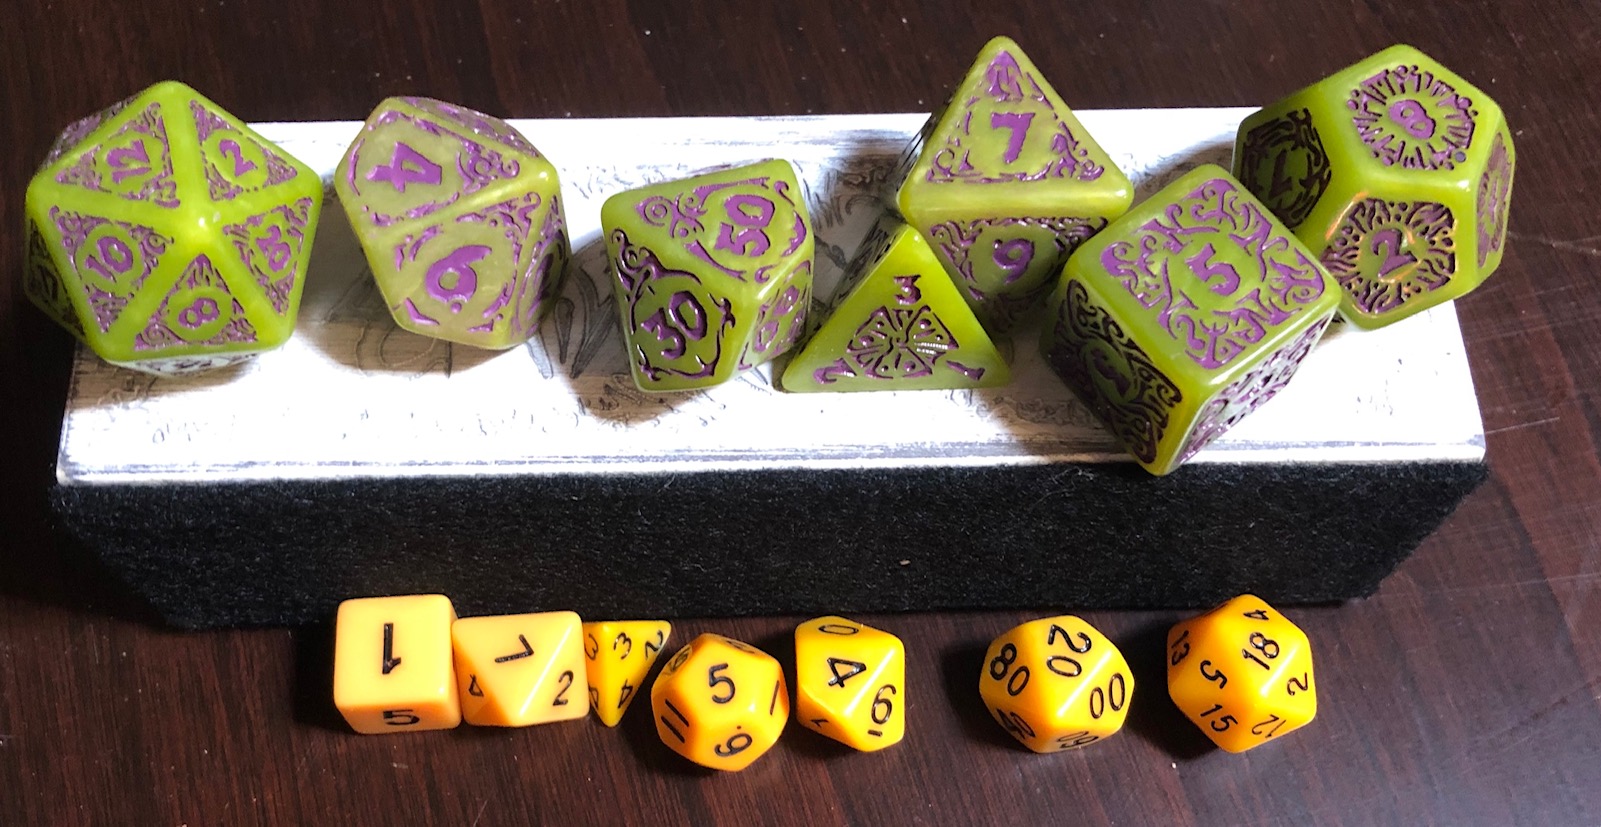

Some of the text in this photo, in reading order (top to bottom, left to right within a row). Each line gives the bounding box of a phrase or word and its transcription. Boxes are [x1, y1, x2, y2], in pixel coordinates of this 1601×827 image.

[991, 112, 1035, 164] 7
[1388, 99, 1436, 140] 8
[105, 139, 152, 184] 12
[218, 139, 258, 177] 2
[366, 141, 442, 193] 4
[713, 194, 776, 257] 50
[84, 236, 133, 283] 10
[1184, 243, 1241, 296] 5
[1372, 228, 1418, 278] 2
[425, 245, 492, 301] 6
[893, 274, 921, 305] 3
[178, 297, 220, 329] 8
[640, 290, 708, 360] 30
[812, 357, 857, 384] 2
[818, 624, 859, 636] 0
[1243, 609, 1270, 621] 4
[382, 622, 402, 675] 1
[494, 634, 534, 664] 7
[613, 631, 632, 660] 3
[644, 630, 663, 659] 2
[1046, 624, 1092, 677] 20
[1171, 630, 1190, 666] 13
[1242, 631, 1280, 671] 18
[468, 674, 484, 697] 4
[552, 670, 574, 706] 2
[708, 662, 736, 704] 5
[827, 657, 867, 688] 4
[990, 643, 1030, 697] 80
[1200, 660, 1228, 689] 5
[1286, 672, 1308, 696] 2
[617, 679, 633, 709] 4
[870, 684, 897, 730] 6
[1089, 672, 1126, 719] 00
[382, 709, 420, 726] 5
[660, 698, 690, 744] 11
[1200, 704, 1238, 732] 15
